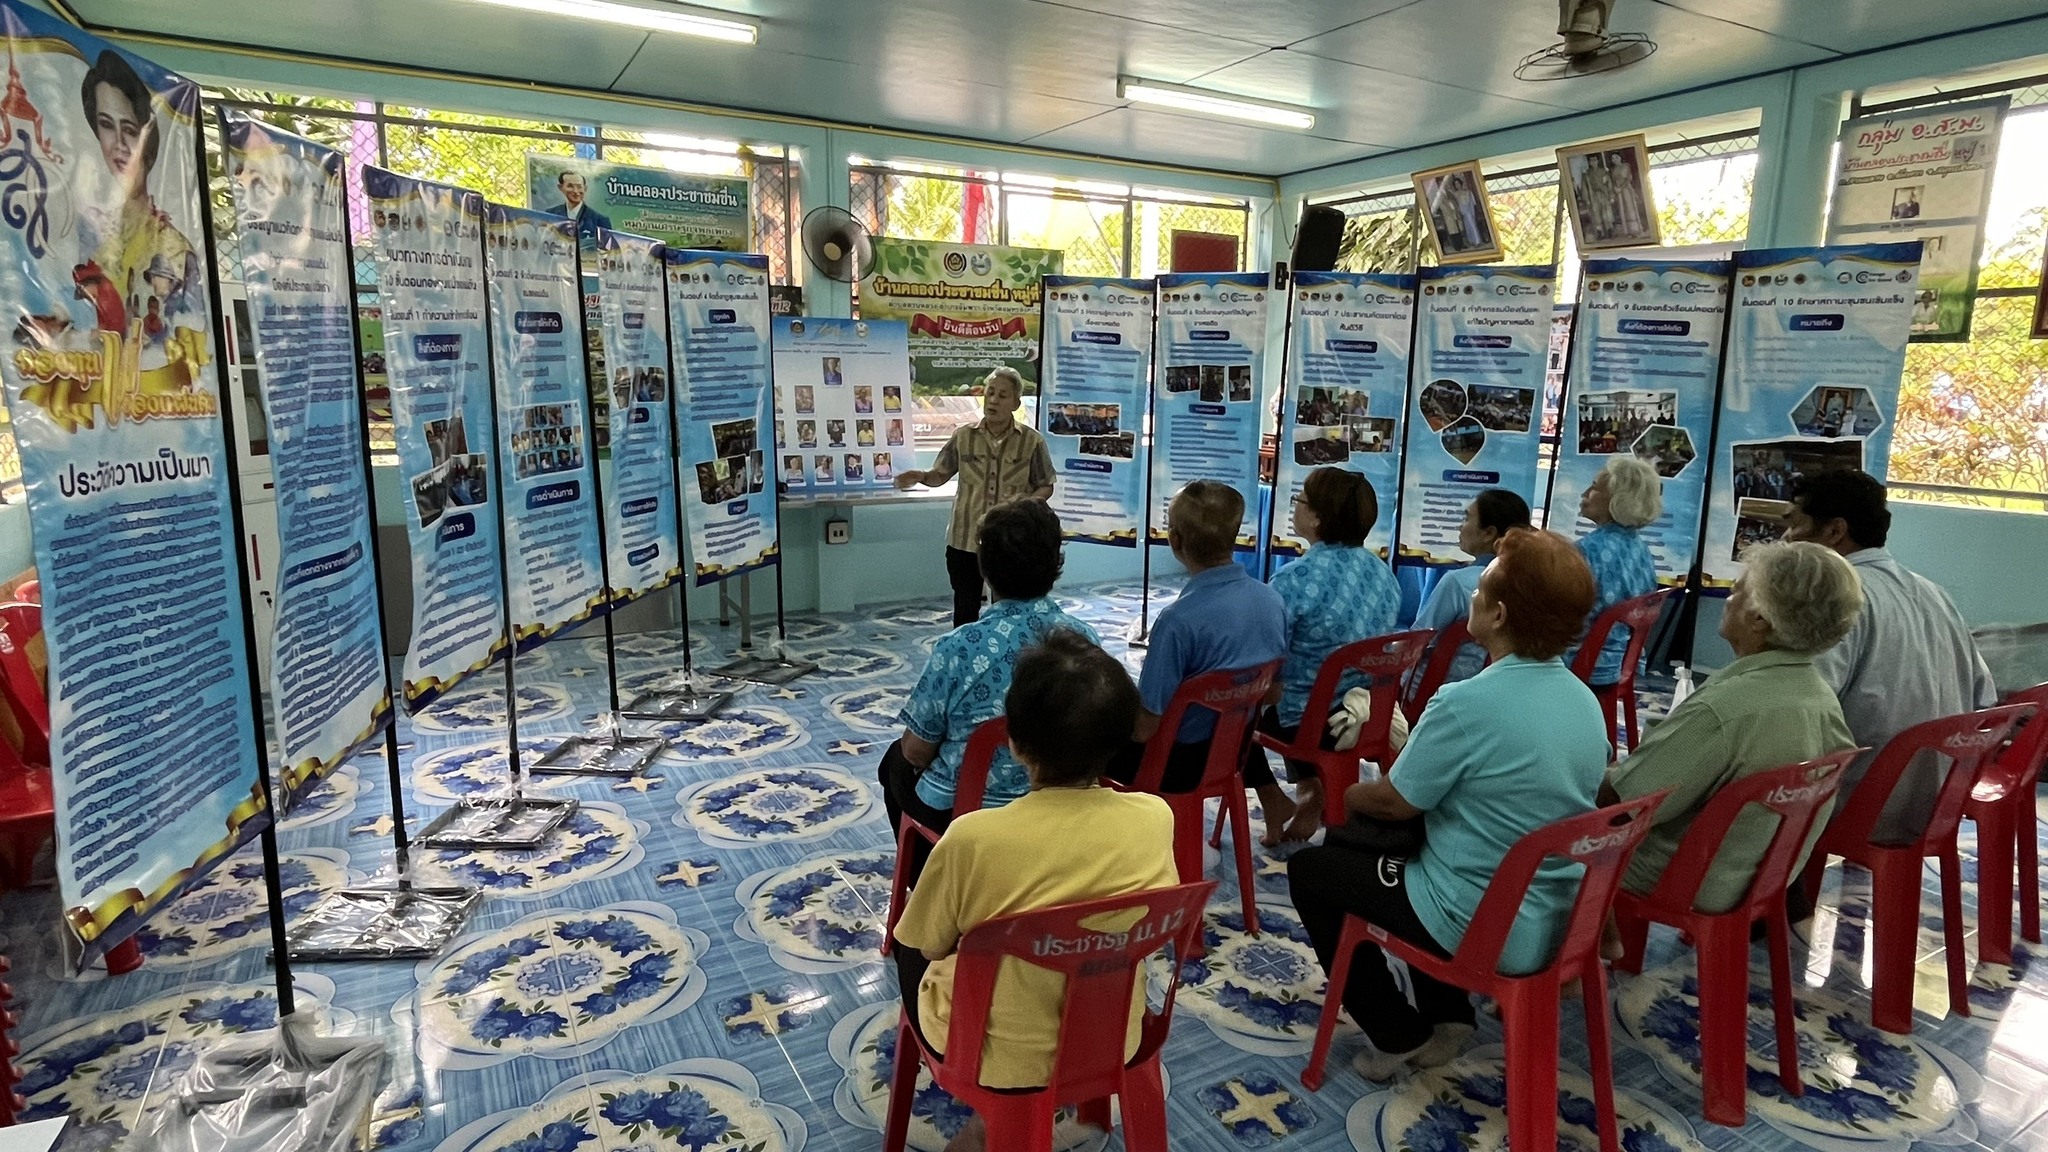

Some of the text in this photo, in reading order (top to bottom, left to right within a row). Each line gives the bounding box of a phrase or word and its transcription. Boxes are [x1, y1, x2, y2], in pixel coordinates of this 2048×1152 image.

[1857, 119, 1905, 155] กลุ่ม
[606, 176, 738, 207] บ้านคลองประชาชมชื่น
[873, 276, 1009, 300] บ้านคลองประชาชมชื่น
[943, 320, 999, 335] ยินดีต้อนรับ
